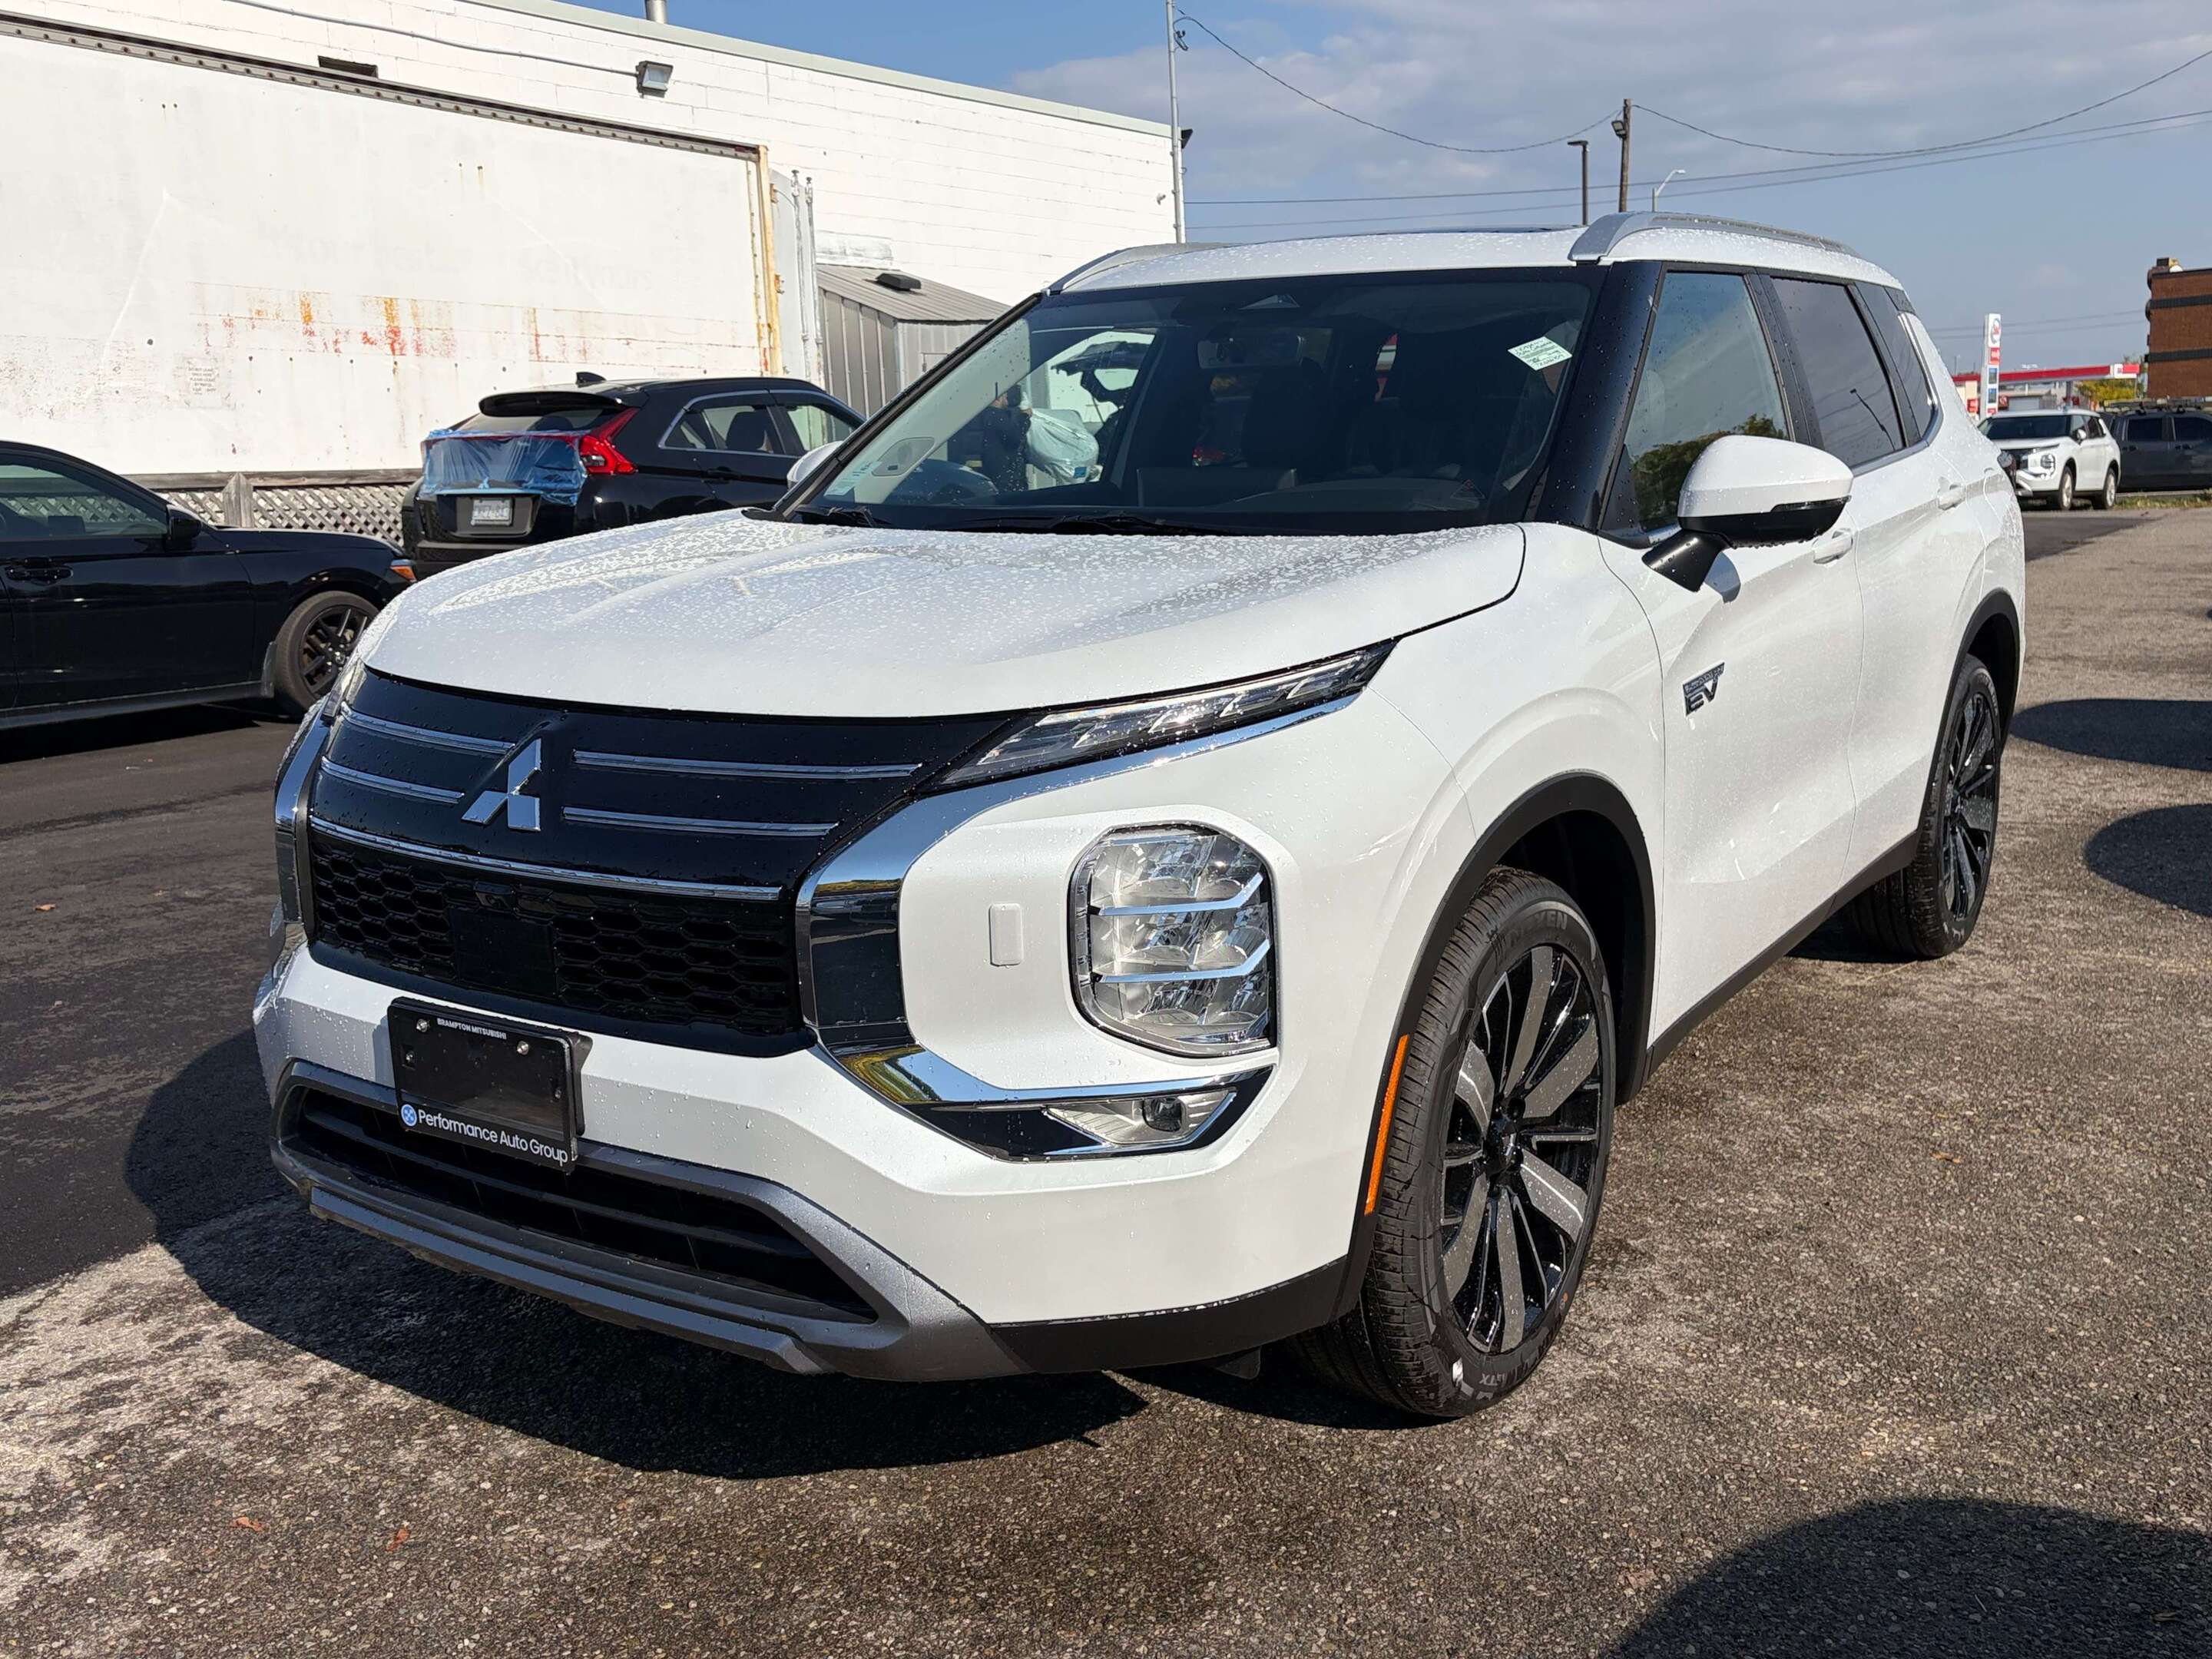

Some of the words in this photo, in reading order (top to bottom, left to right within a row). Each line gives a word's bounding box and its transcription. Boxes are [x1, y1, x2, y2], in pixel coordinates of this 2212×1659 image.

[436, 1018, 471, 1032] BRAMPTON
[471, 1025, 507, 1040] MITSUBISHI
[418, 1109, 498, 1143] Performance
[500, 1130, 528, 1151] Auto
[529, 1138, 568, 1167] Group
